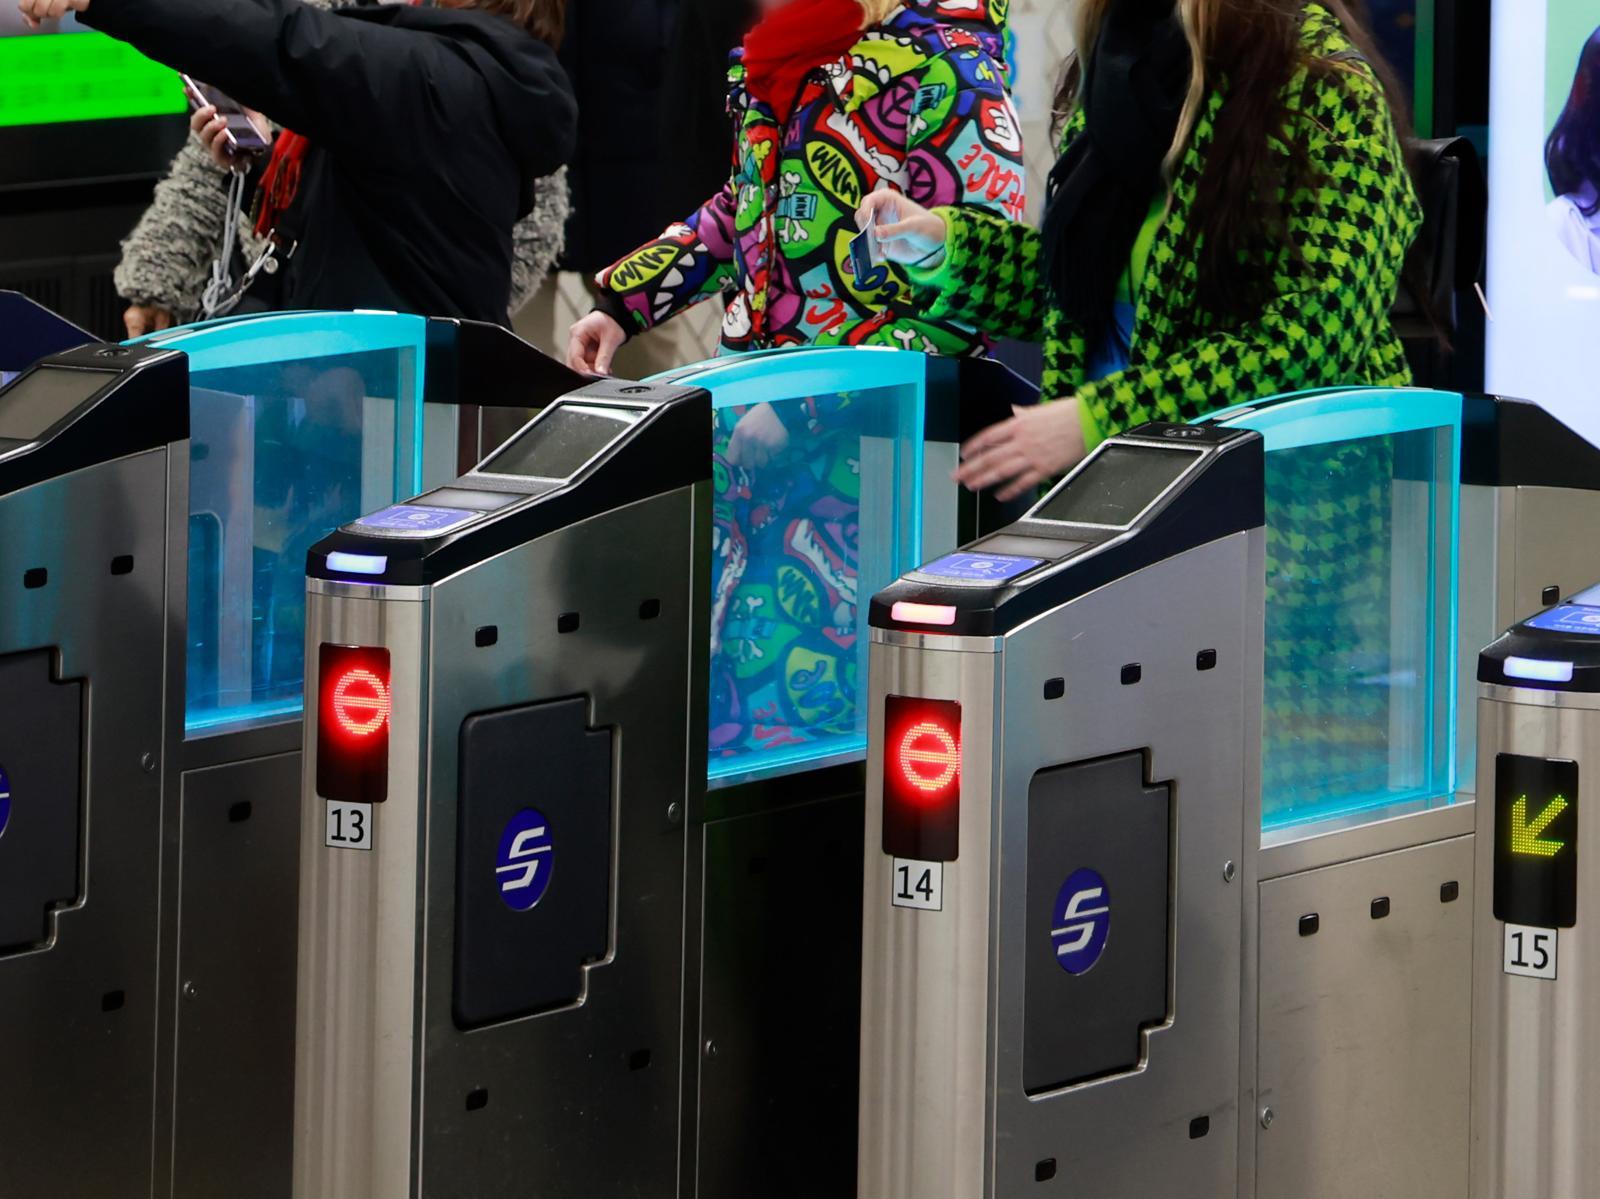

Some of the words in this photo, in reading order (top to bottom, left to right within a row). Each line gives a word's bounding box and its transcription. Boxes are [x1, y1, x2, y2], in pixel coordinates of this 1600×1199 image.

[330, 808, 366, 843] 13
[897, 865, 934, 901] 14
[1510, 931, 1549, 969] 15
